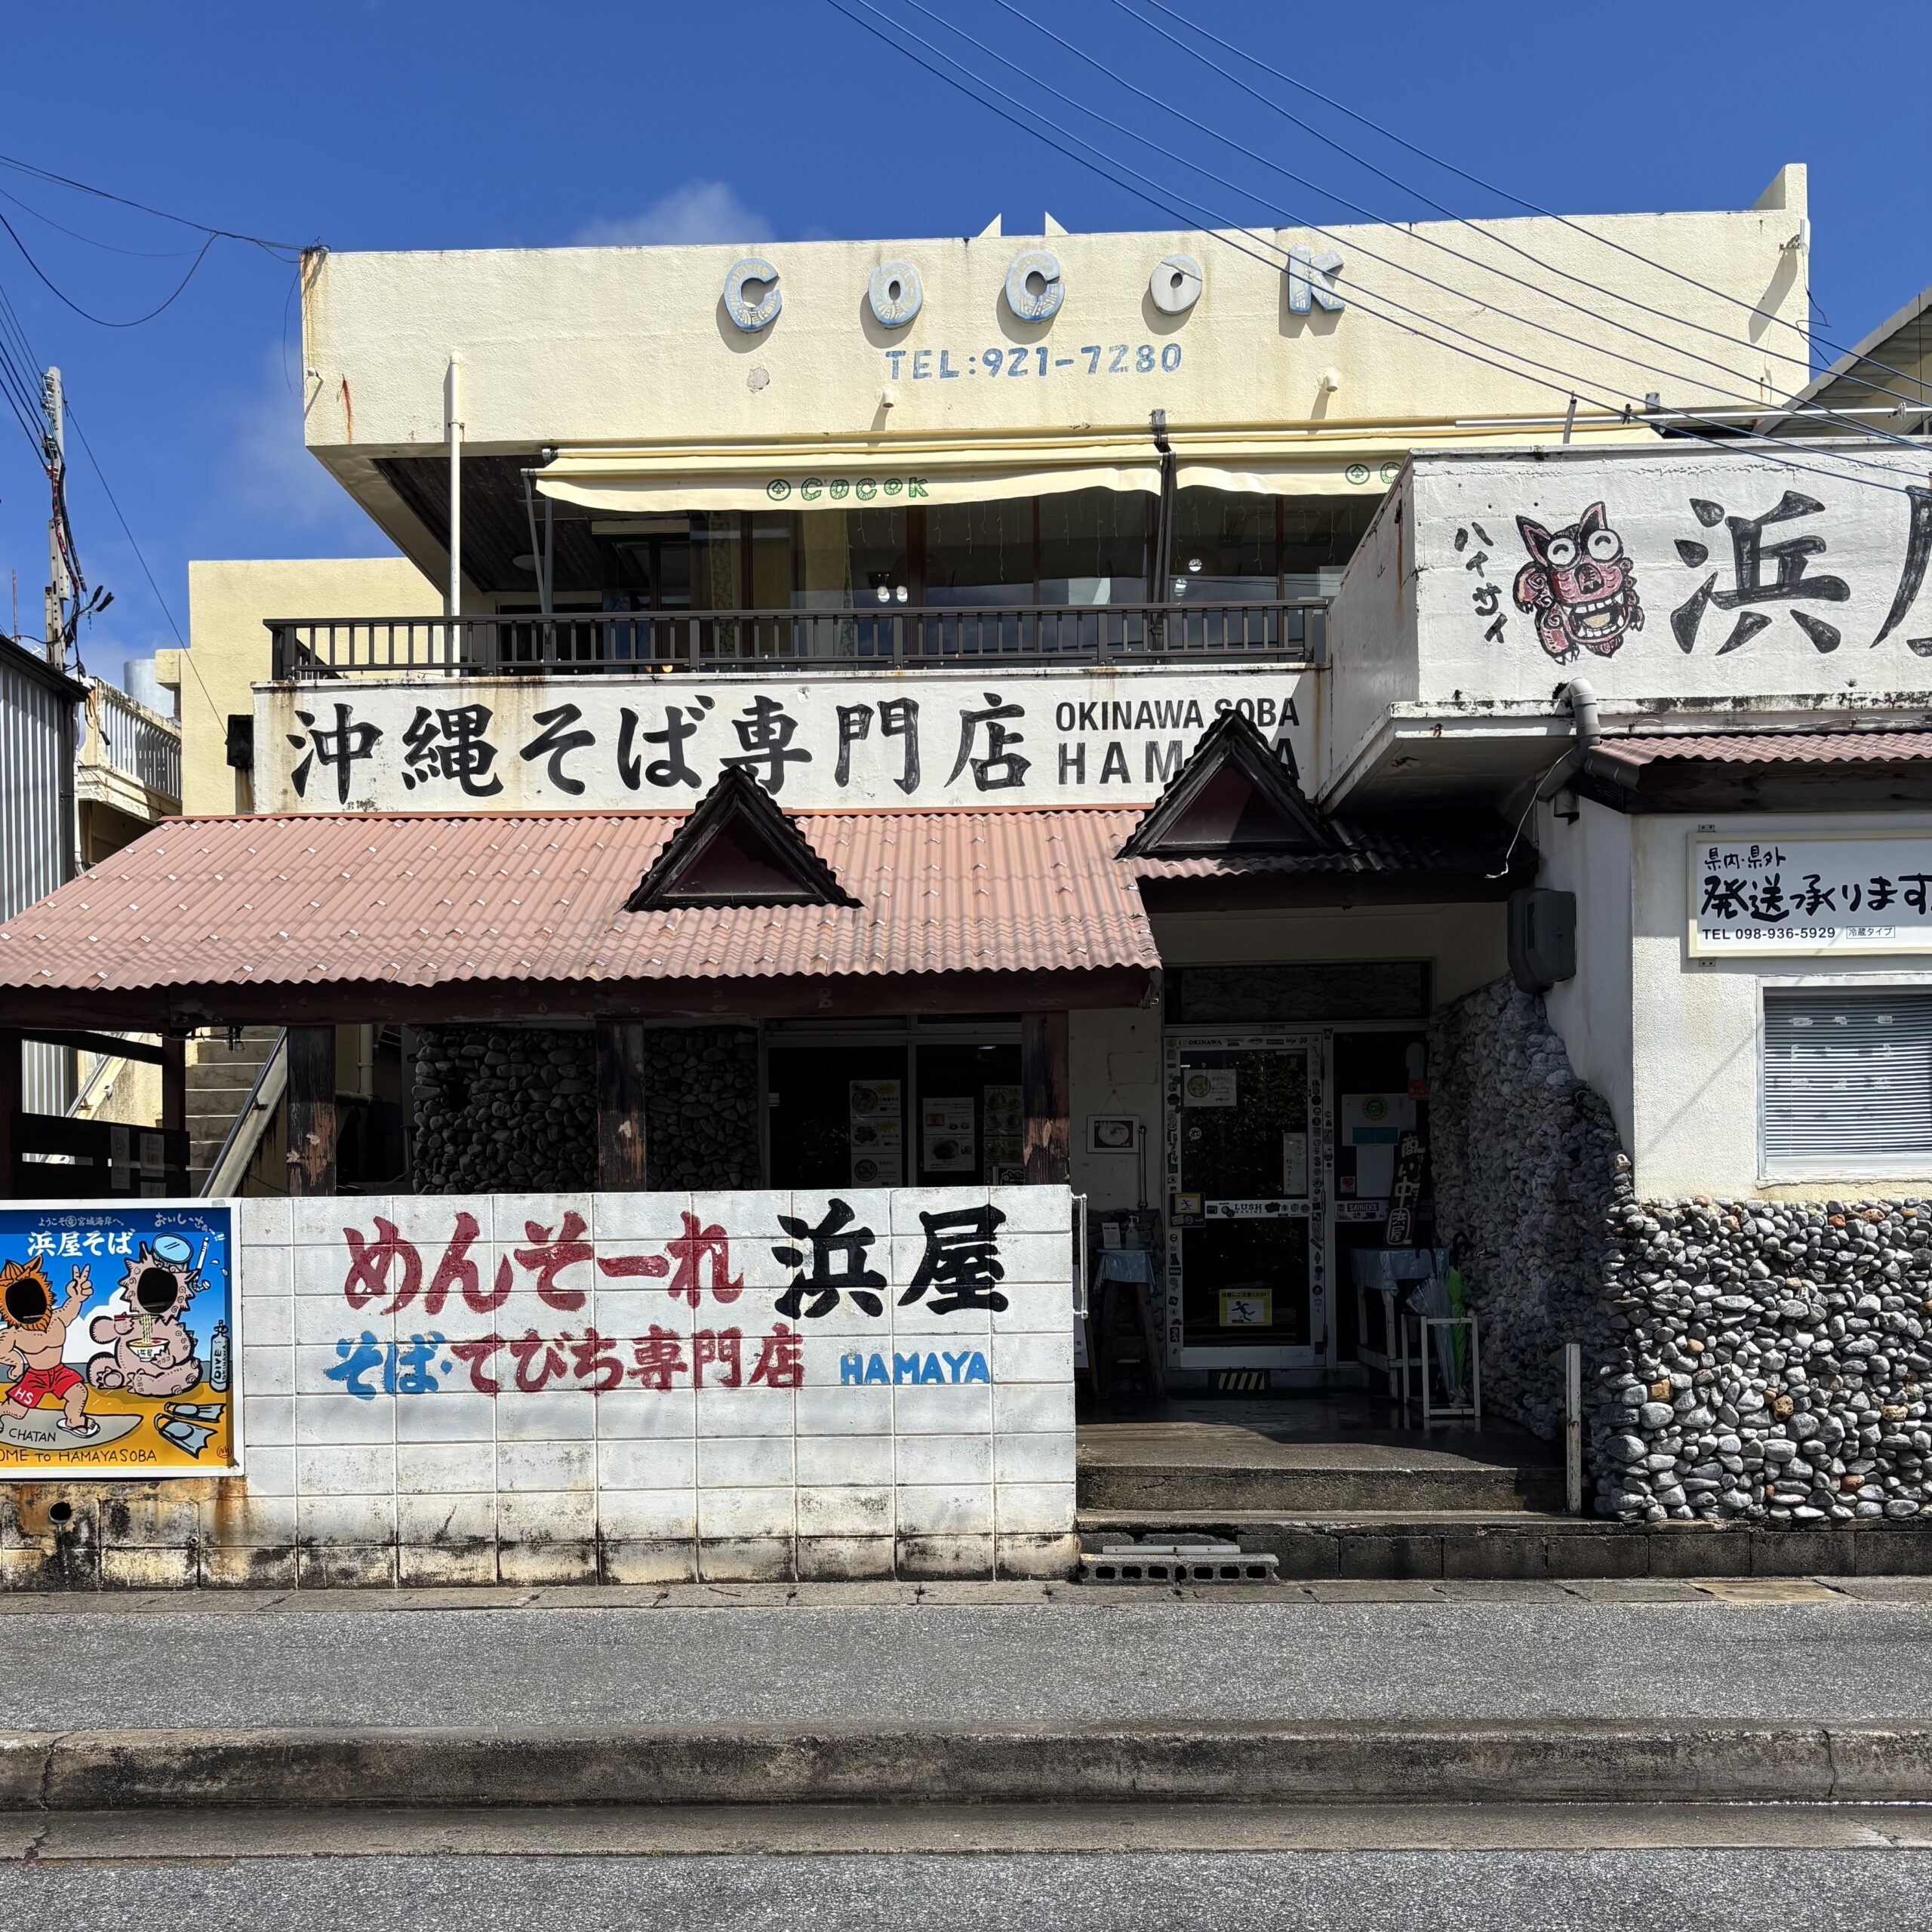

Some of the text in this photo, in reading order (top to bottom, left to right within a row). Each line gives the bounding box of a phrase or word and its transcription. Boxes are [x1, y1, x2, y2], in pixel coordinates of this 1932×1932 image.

[724, 245, 1346, 333] COCOK
[884, 343, 1183, 380] TEL:921-7280
[801, 477, 929, 501] COCOK
[1454, 521, 1508, 644] ハイサイ
[1056, 700, 1204, 732] OKINAWA
[286, 693, 1032, 804] 沖縄そば専門店
[1057, 738, 1300, 785] HAMA
[1701, 872, 1932, 922] 発送承ります
[1702, 927, 1835, 940] TEL 098-936-5929
[28, 1228, 137, 1257] 浜屋そば
[343, 1198, 1009, 1319] めんそーれ 浜屋
[840, 1351, 991, 1385] HAMAYA
[14, 1387, 34, 1405] HS
[9, 1428, 57, 1442] CHATAN
